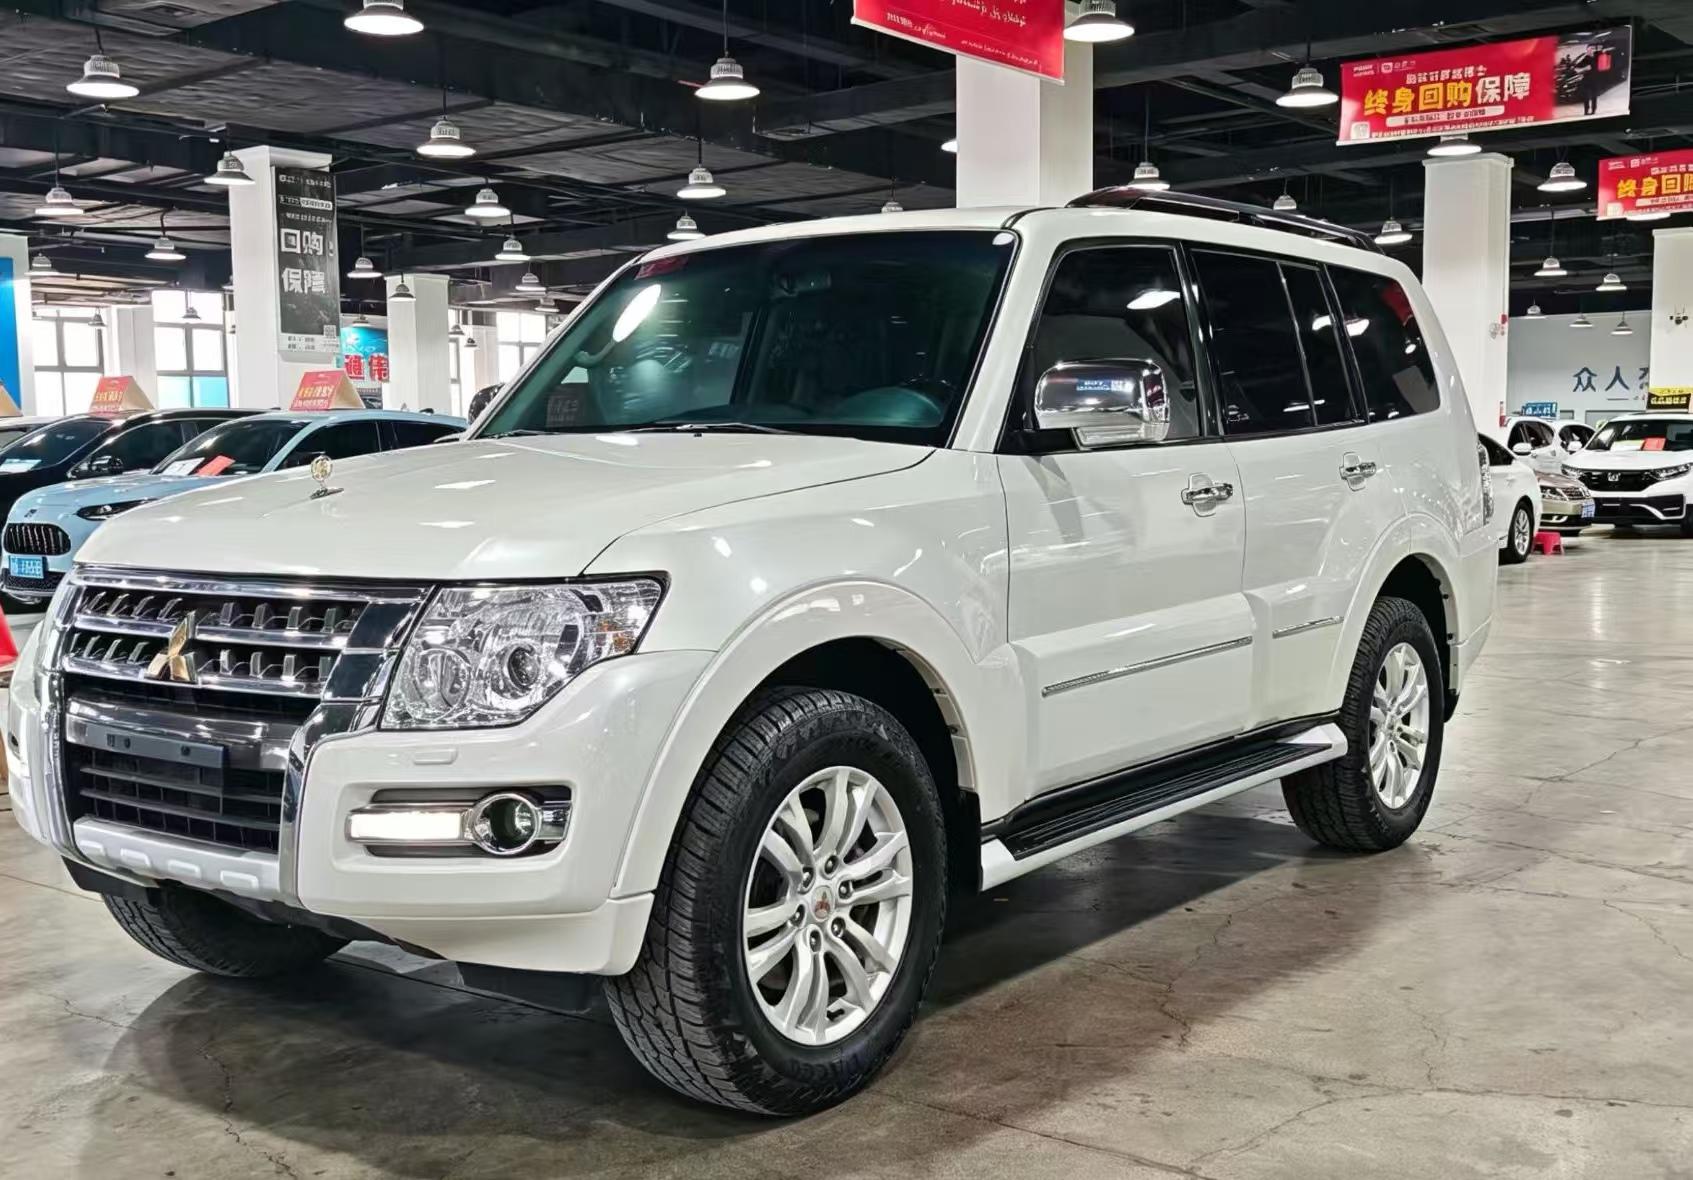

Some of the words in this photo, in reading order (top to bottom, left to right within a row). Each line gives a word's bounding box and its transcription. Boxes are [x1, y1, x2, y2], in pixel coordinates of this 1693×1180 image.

[1363, 72, 1531, 115] 终身回购保障
[282, 267, 326, 294] 保障
